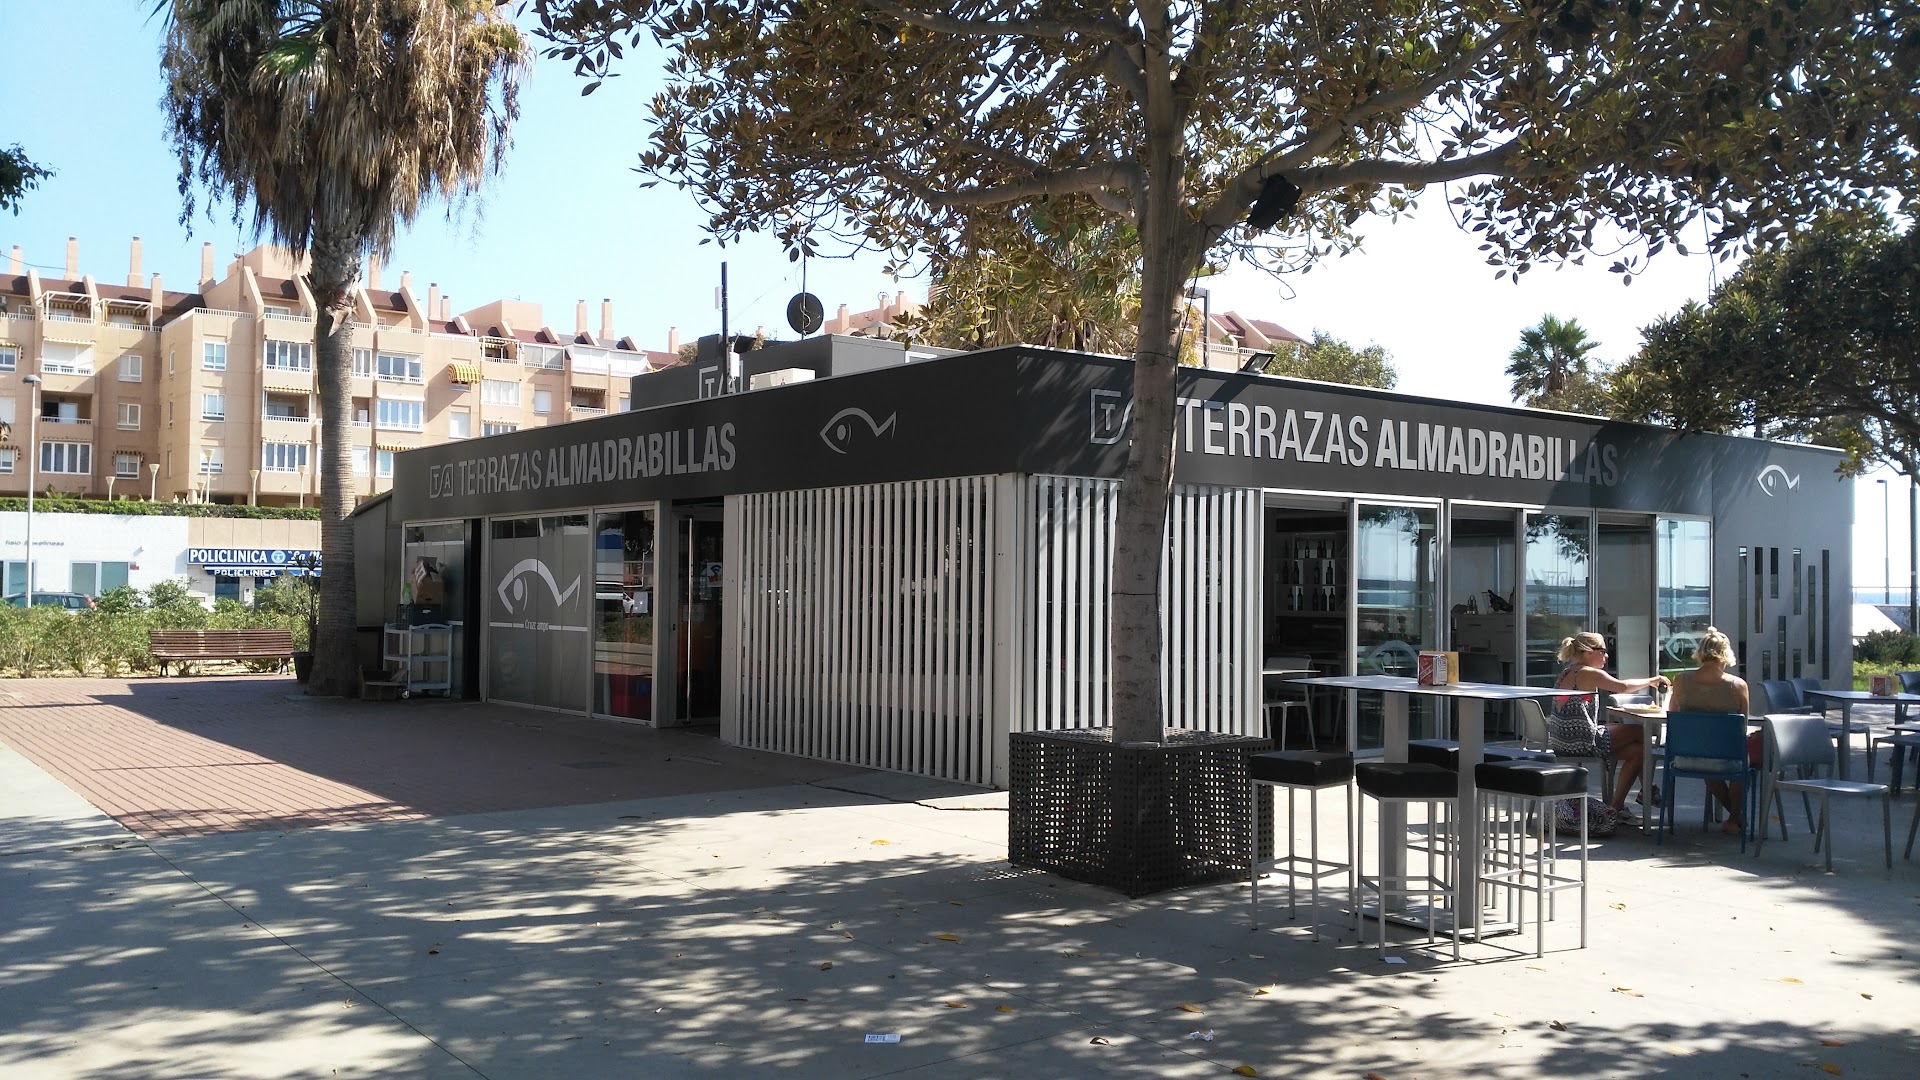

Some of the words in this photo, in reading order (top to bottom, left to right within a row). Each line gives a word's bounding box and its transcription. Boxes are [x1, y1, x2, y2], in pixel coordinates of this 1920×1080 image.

[459, 450, 542, 496] TERRAZAS
[545, 423, 736, 487] ALMADRABILLAS
[1177, 397, 1369, 467] TERRAZAS
[1375, 419, 1618, 487] ALMADRABILLAS
[190, 549, 268, 563] POLICLINICA
[214, 569, 277, 577] POLICLINICA
